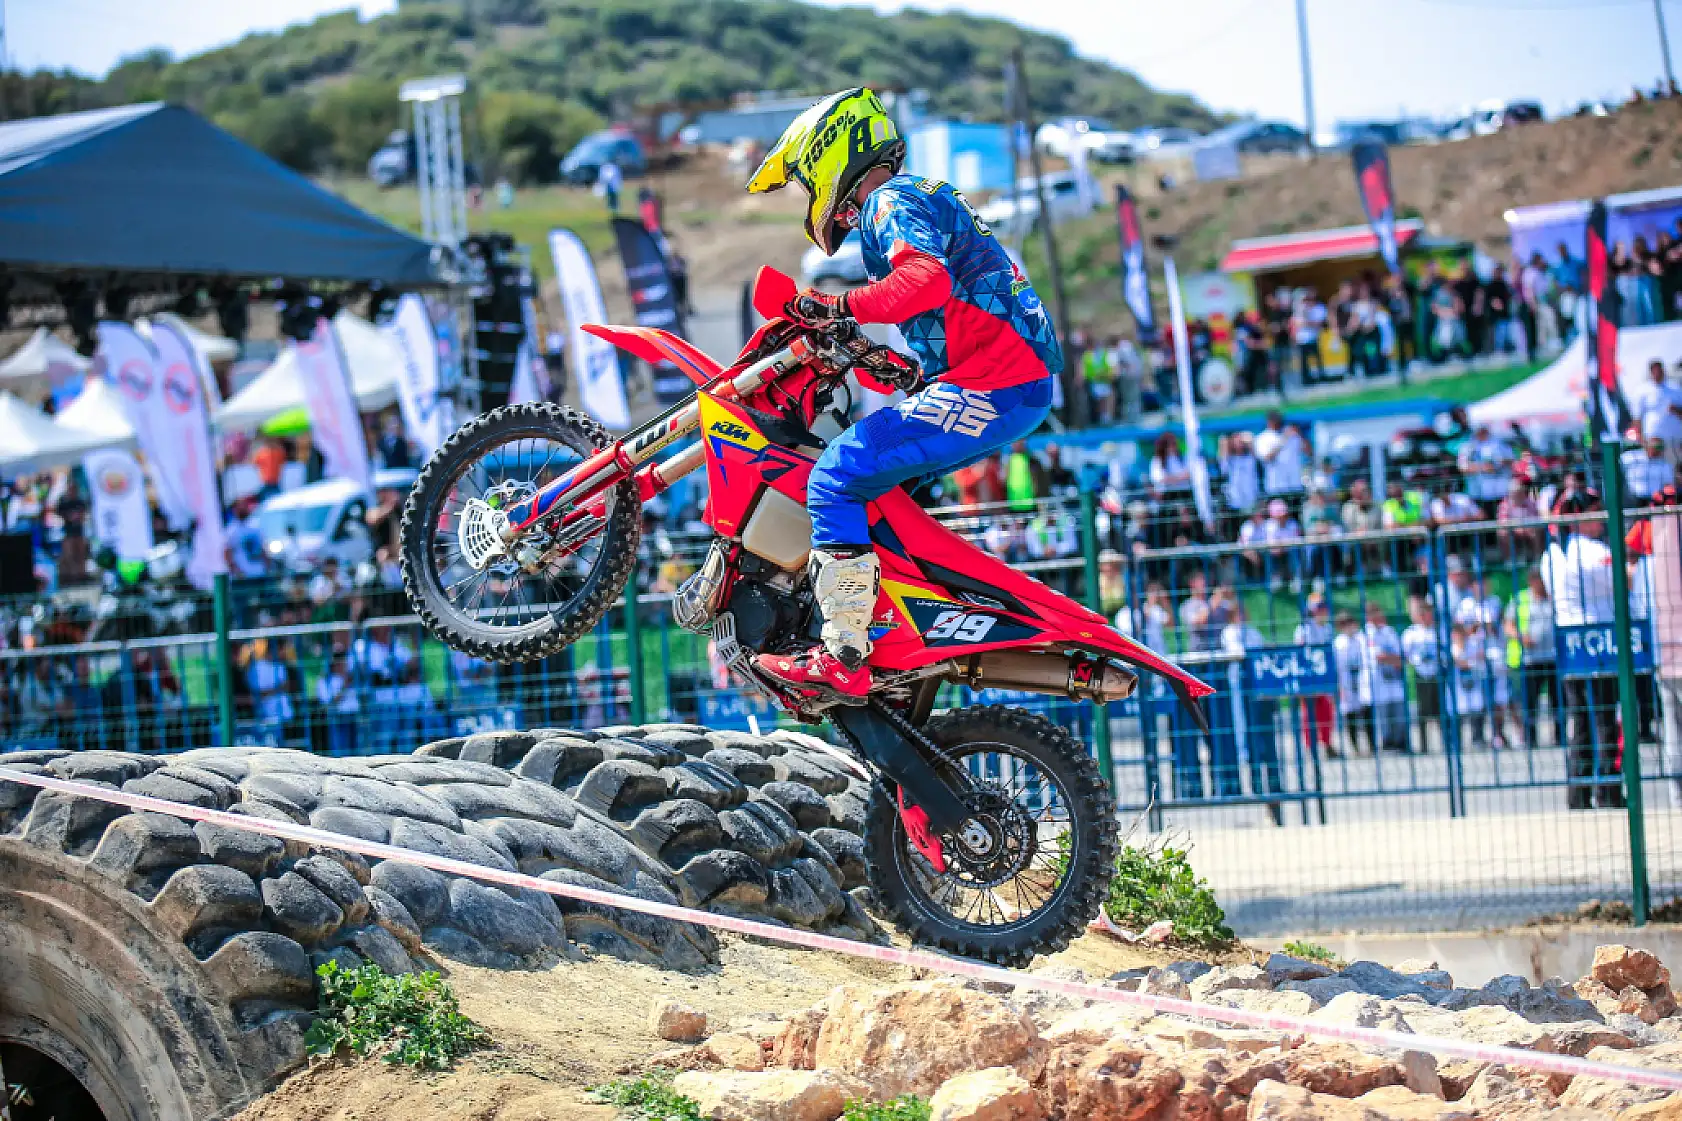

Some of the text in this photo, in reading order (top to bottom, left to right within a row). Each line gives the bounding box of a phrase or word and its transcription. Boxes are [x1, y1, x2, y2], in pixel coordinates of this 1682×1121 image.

[803, 110, 856, 173] 100%
[710, 420, 751, 441] KTM
[925, 610, 998, 642] 99
[1565, 626, 1644, 658] POLS
[1254, 648, 1328, 680] POLS
